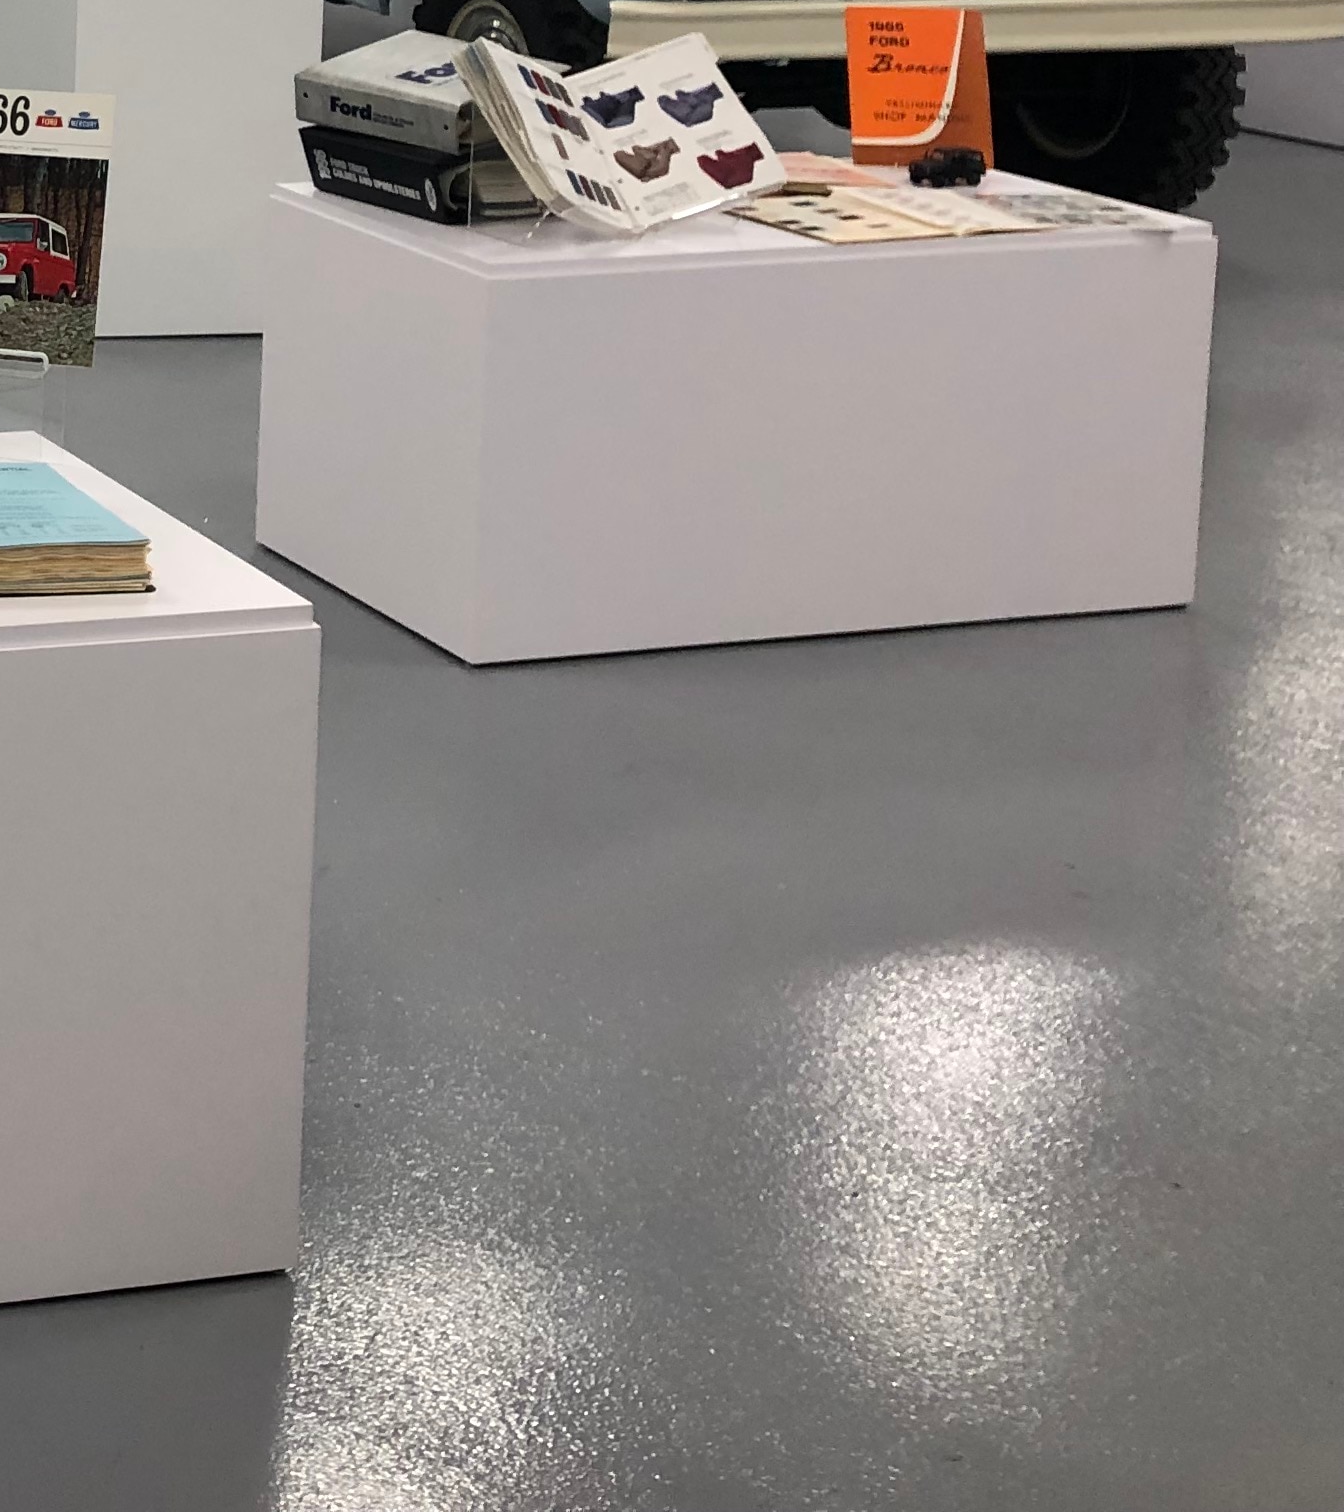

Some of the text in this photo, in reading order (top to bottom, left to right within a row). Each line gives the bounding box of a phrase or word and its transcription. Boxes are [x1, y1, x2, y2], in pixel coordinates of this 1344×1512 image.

[869, 35, 910, 48] FORD
[867, 53, 949, 75] Bronco
[330, 95, 372, 121] Ford
